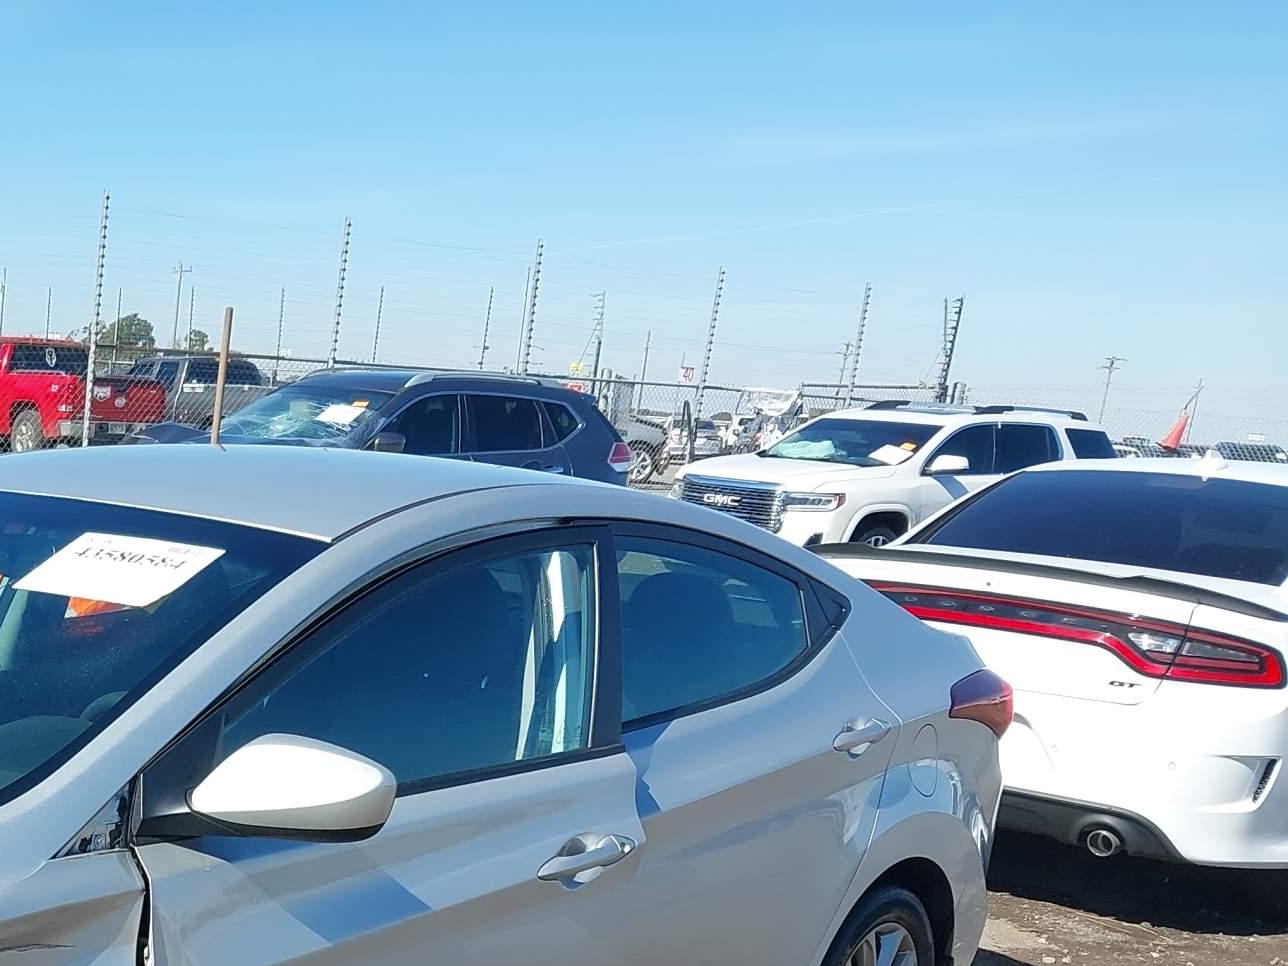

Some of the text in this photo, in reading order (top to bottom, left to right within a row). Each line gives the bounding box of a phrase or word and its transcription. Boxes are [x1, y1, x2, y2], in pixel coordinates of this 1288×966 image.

[682, 367, 695, 382] 40
[703, 493, 741, 506] GMC
[1109, 680, 1142, 688] GT
